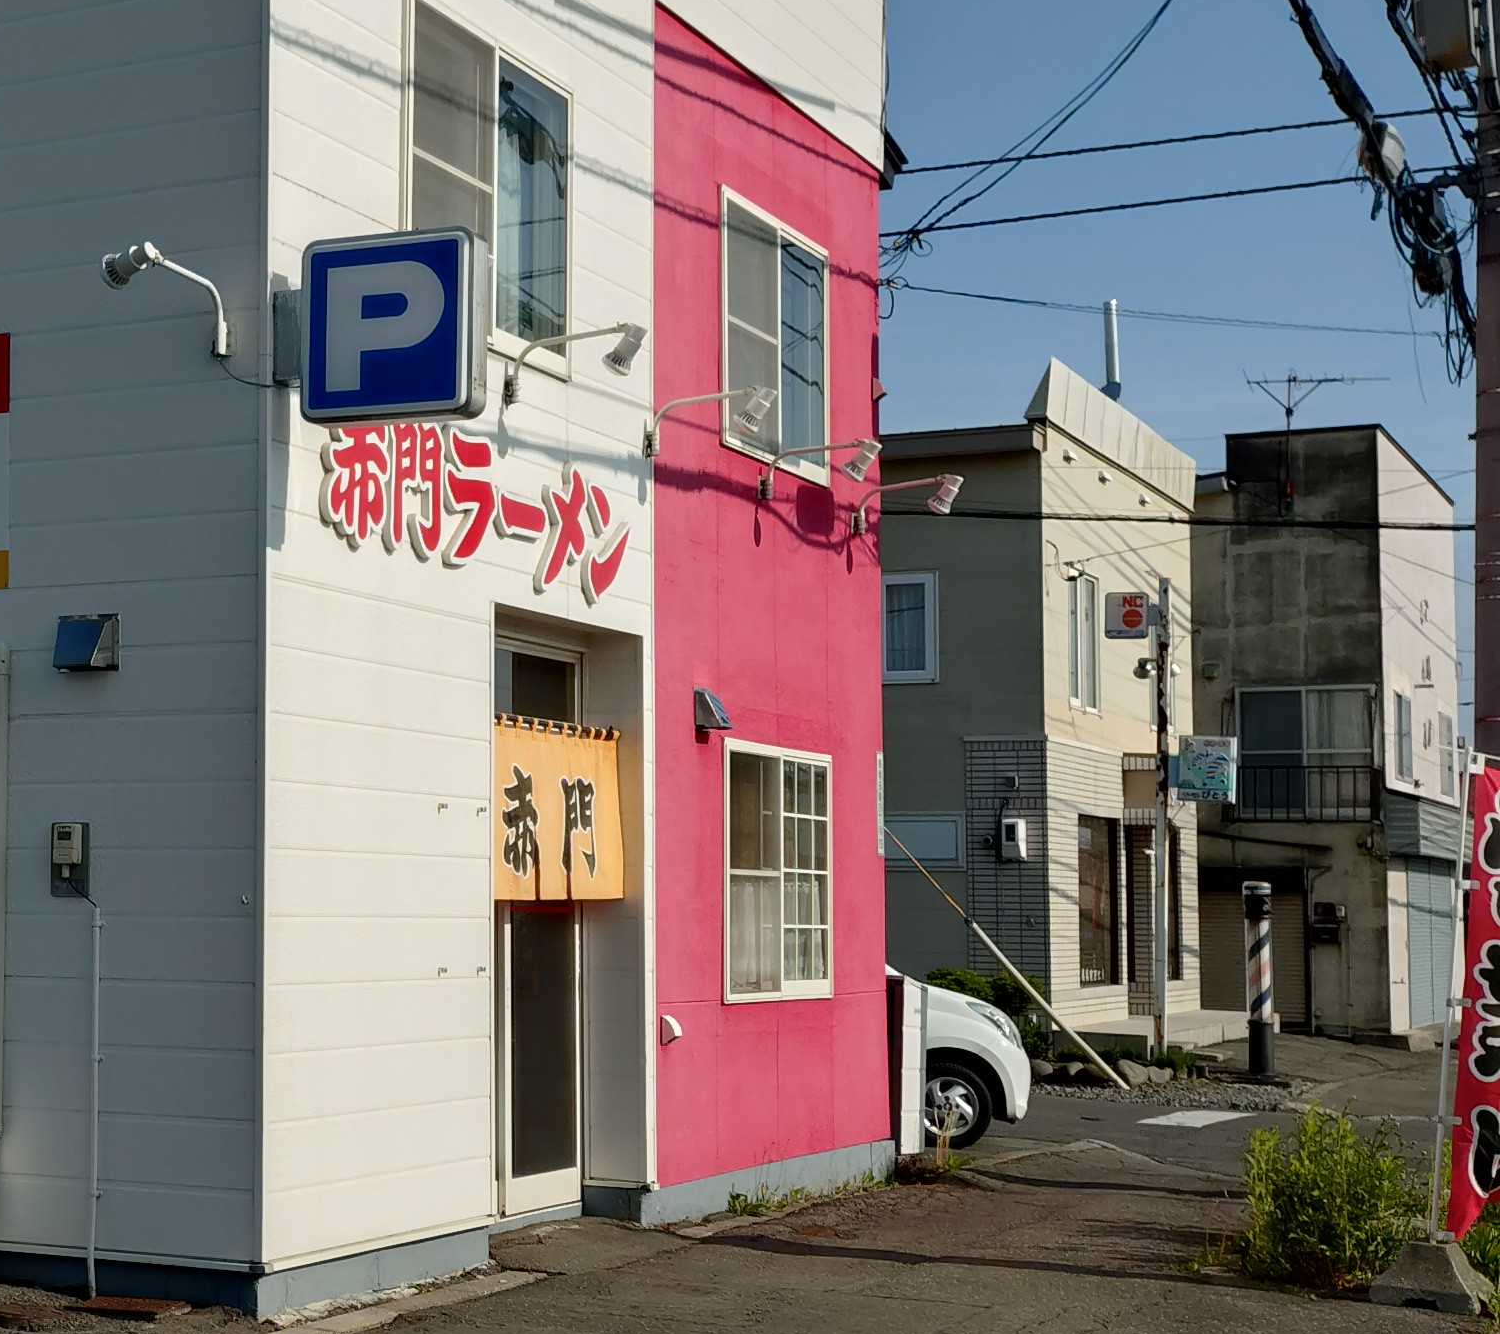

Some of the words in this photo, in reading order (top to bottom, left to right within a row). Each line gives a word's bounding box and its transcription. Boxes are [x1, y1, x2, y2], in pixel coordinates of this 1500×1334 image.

[325, 260, 445, 392] P
[329, 423, 631, 599] 赤門ラーメン
[501, 763, 596, 880] 赤門
